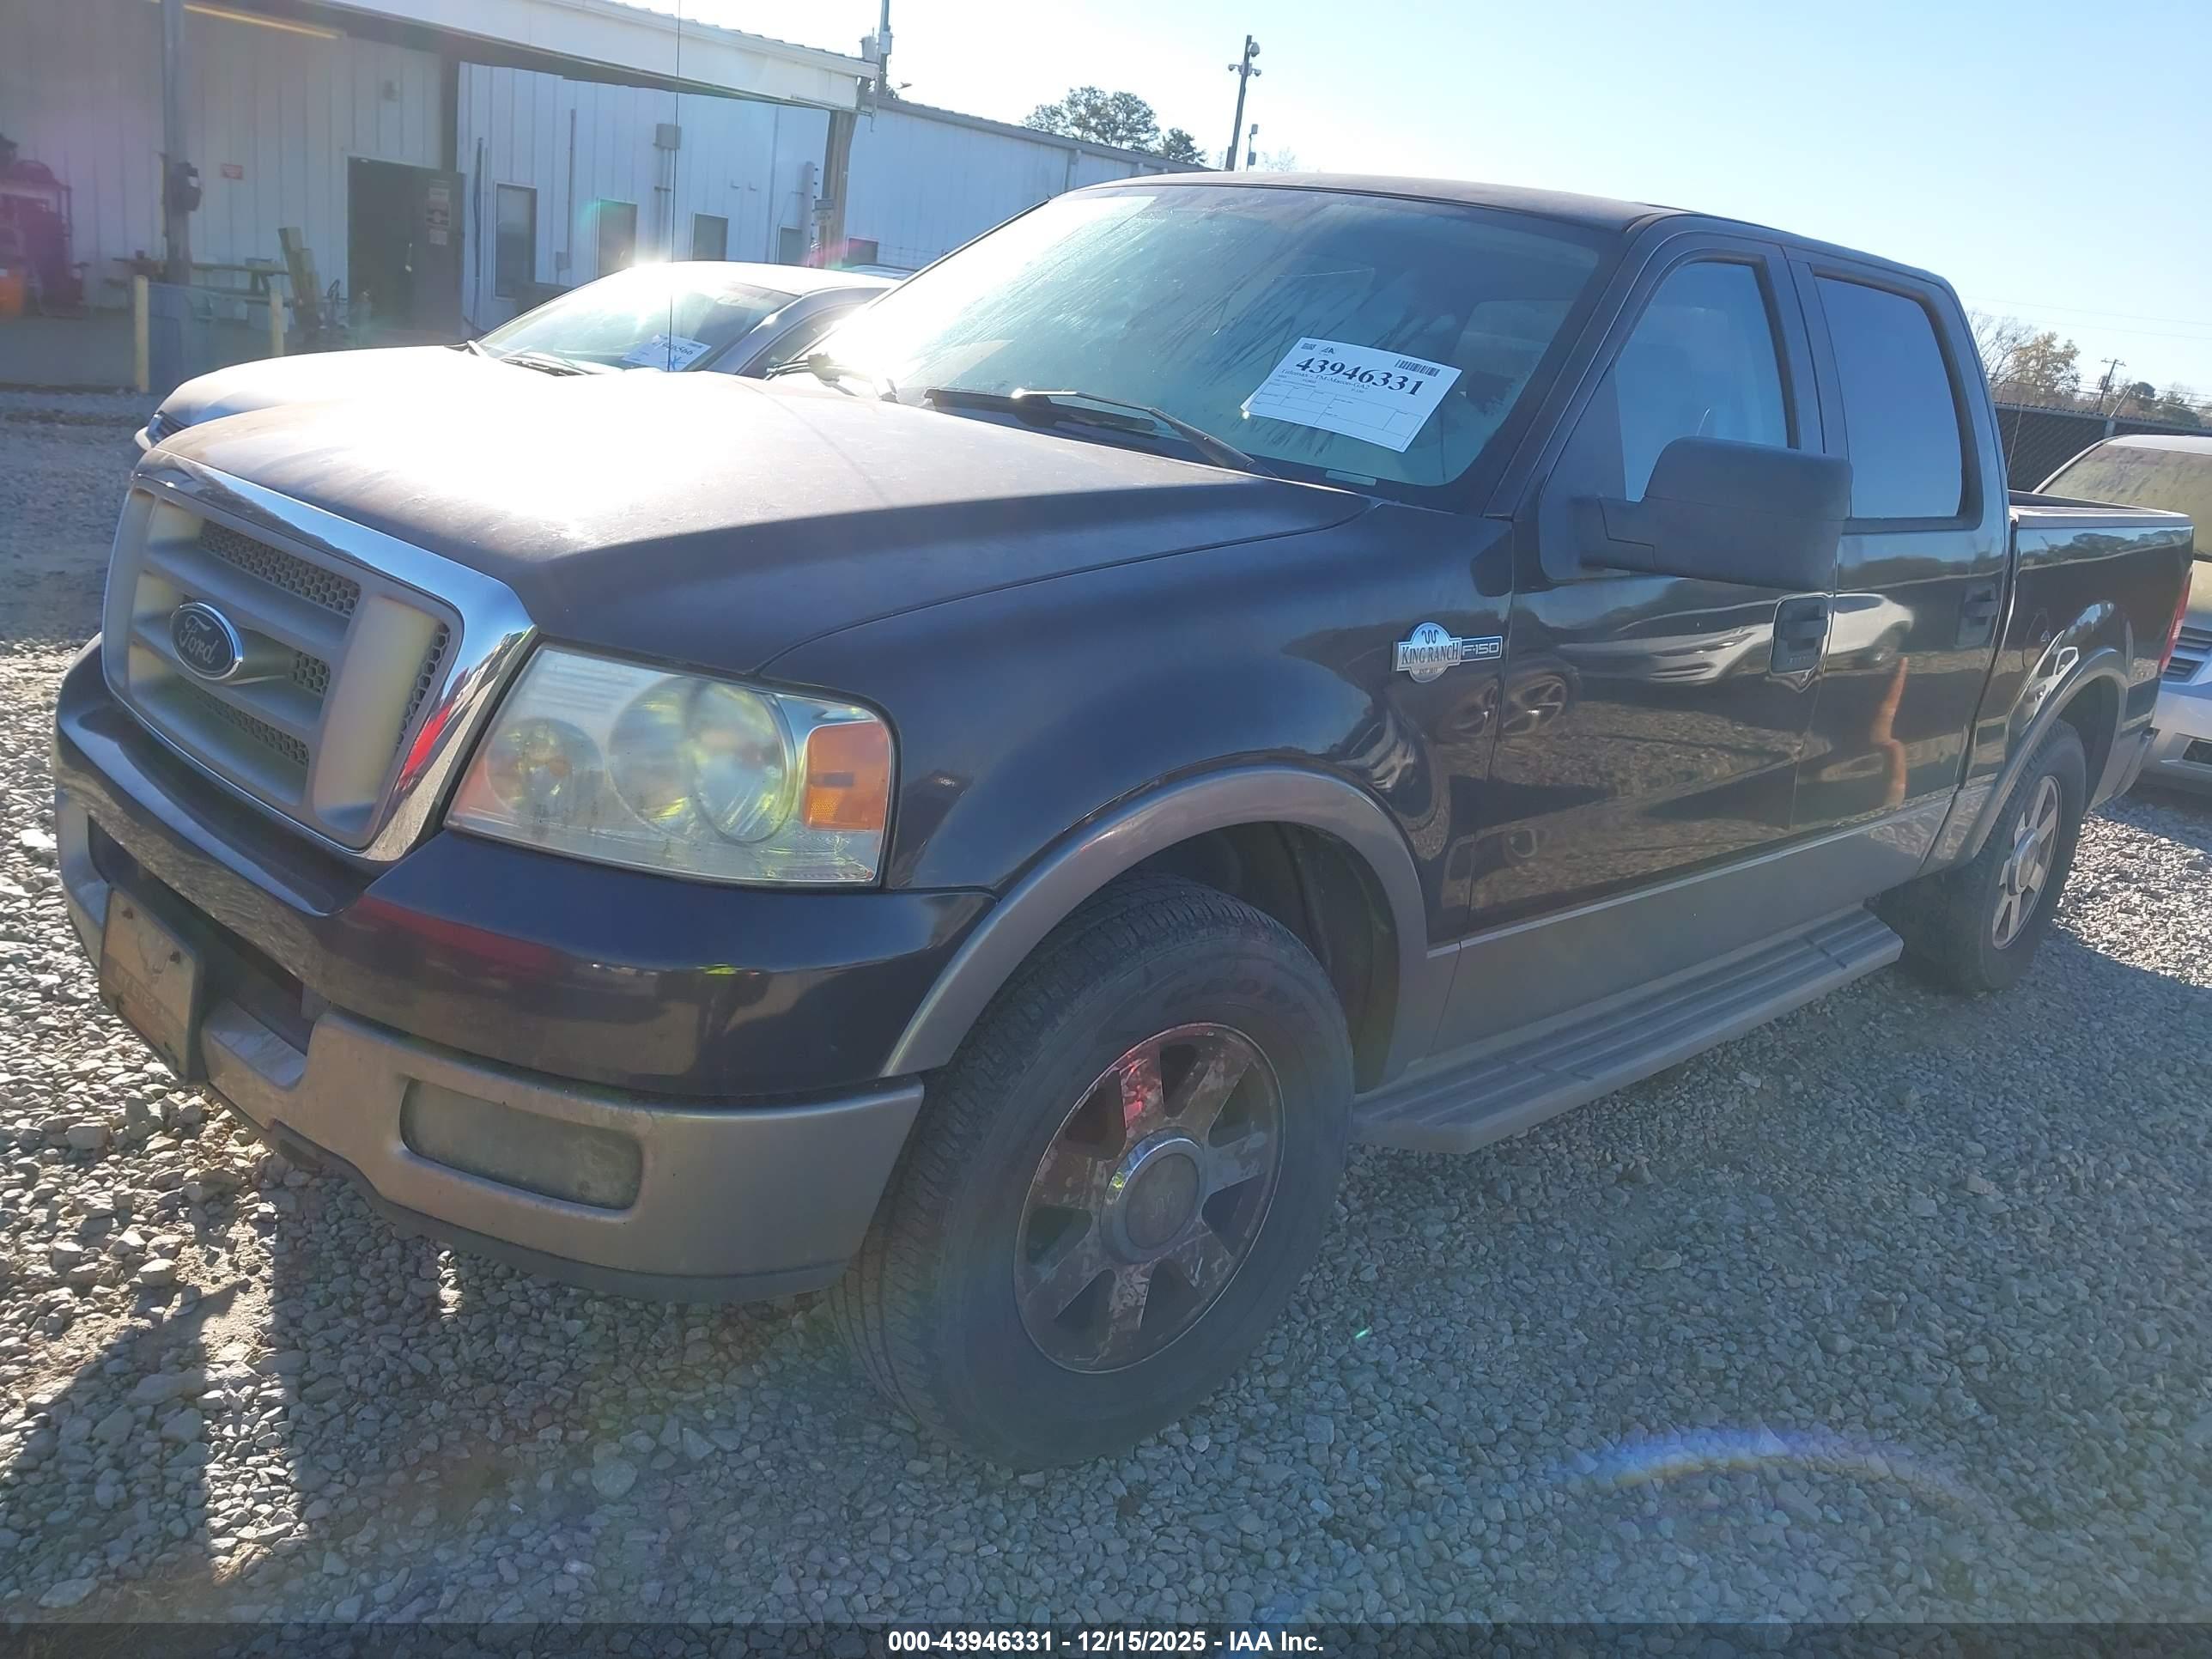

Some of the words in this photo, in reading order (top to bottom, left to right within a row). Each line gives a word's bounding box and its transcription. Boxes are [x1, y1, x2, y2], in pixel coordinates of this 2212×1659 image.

[1296, 357, 1425, 396] 43946331
[179, 615, 220, 665] Ford
[1401, 646, 1426, 665] KING
[1427, 641, 1459, 662] RANCH
[1462, 642, 1499, 656] F-150
